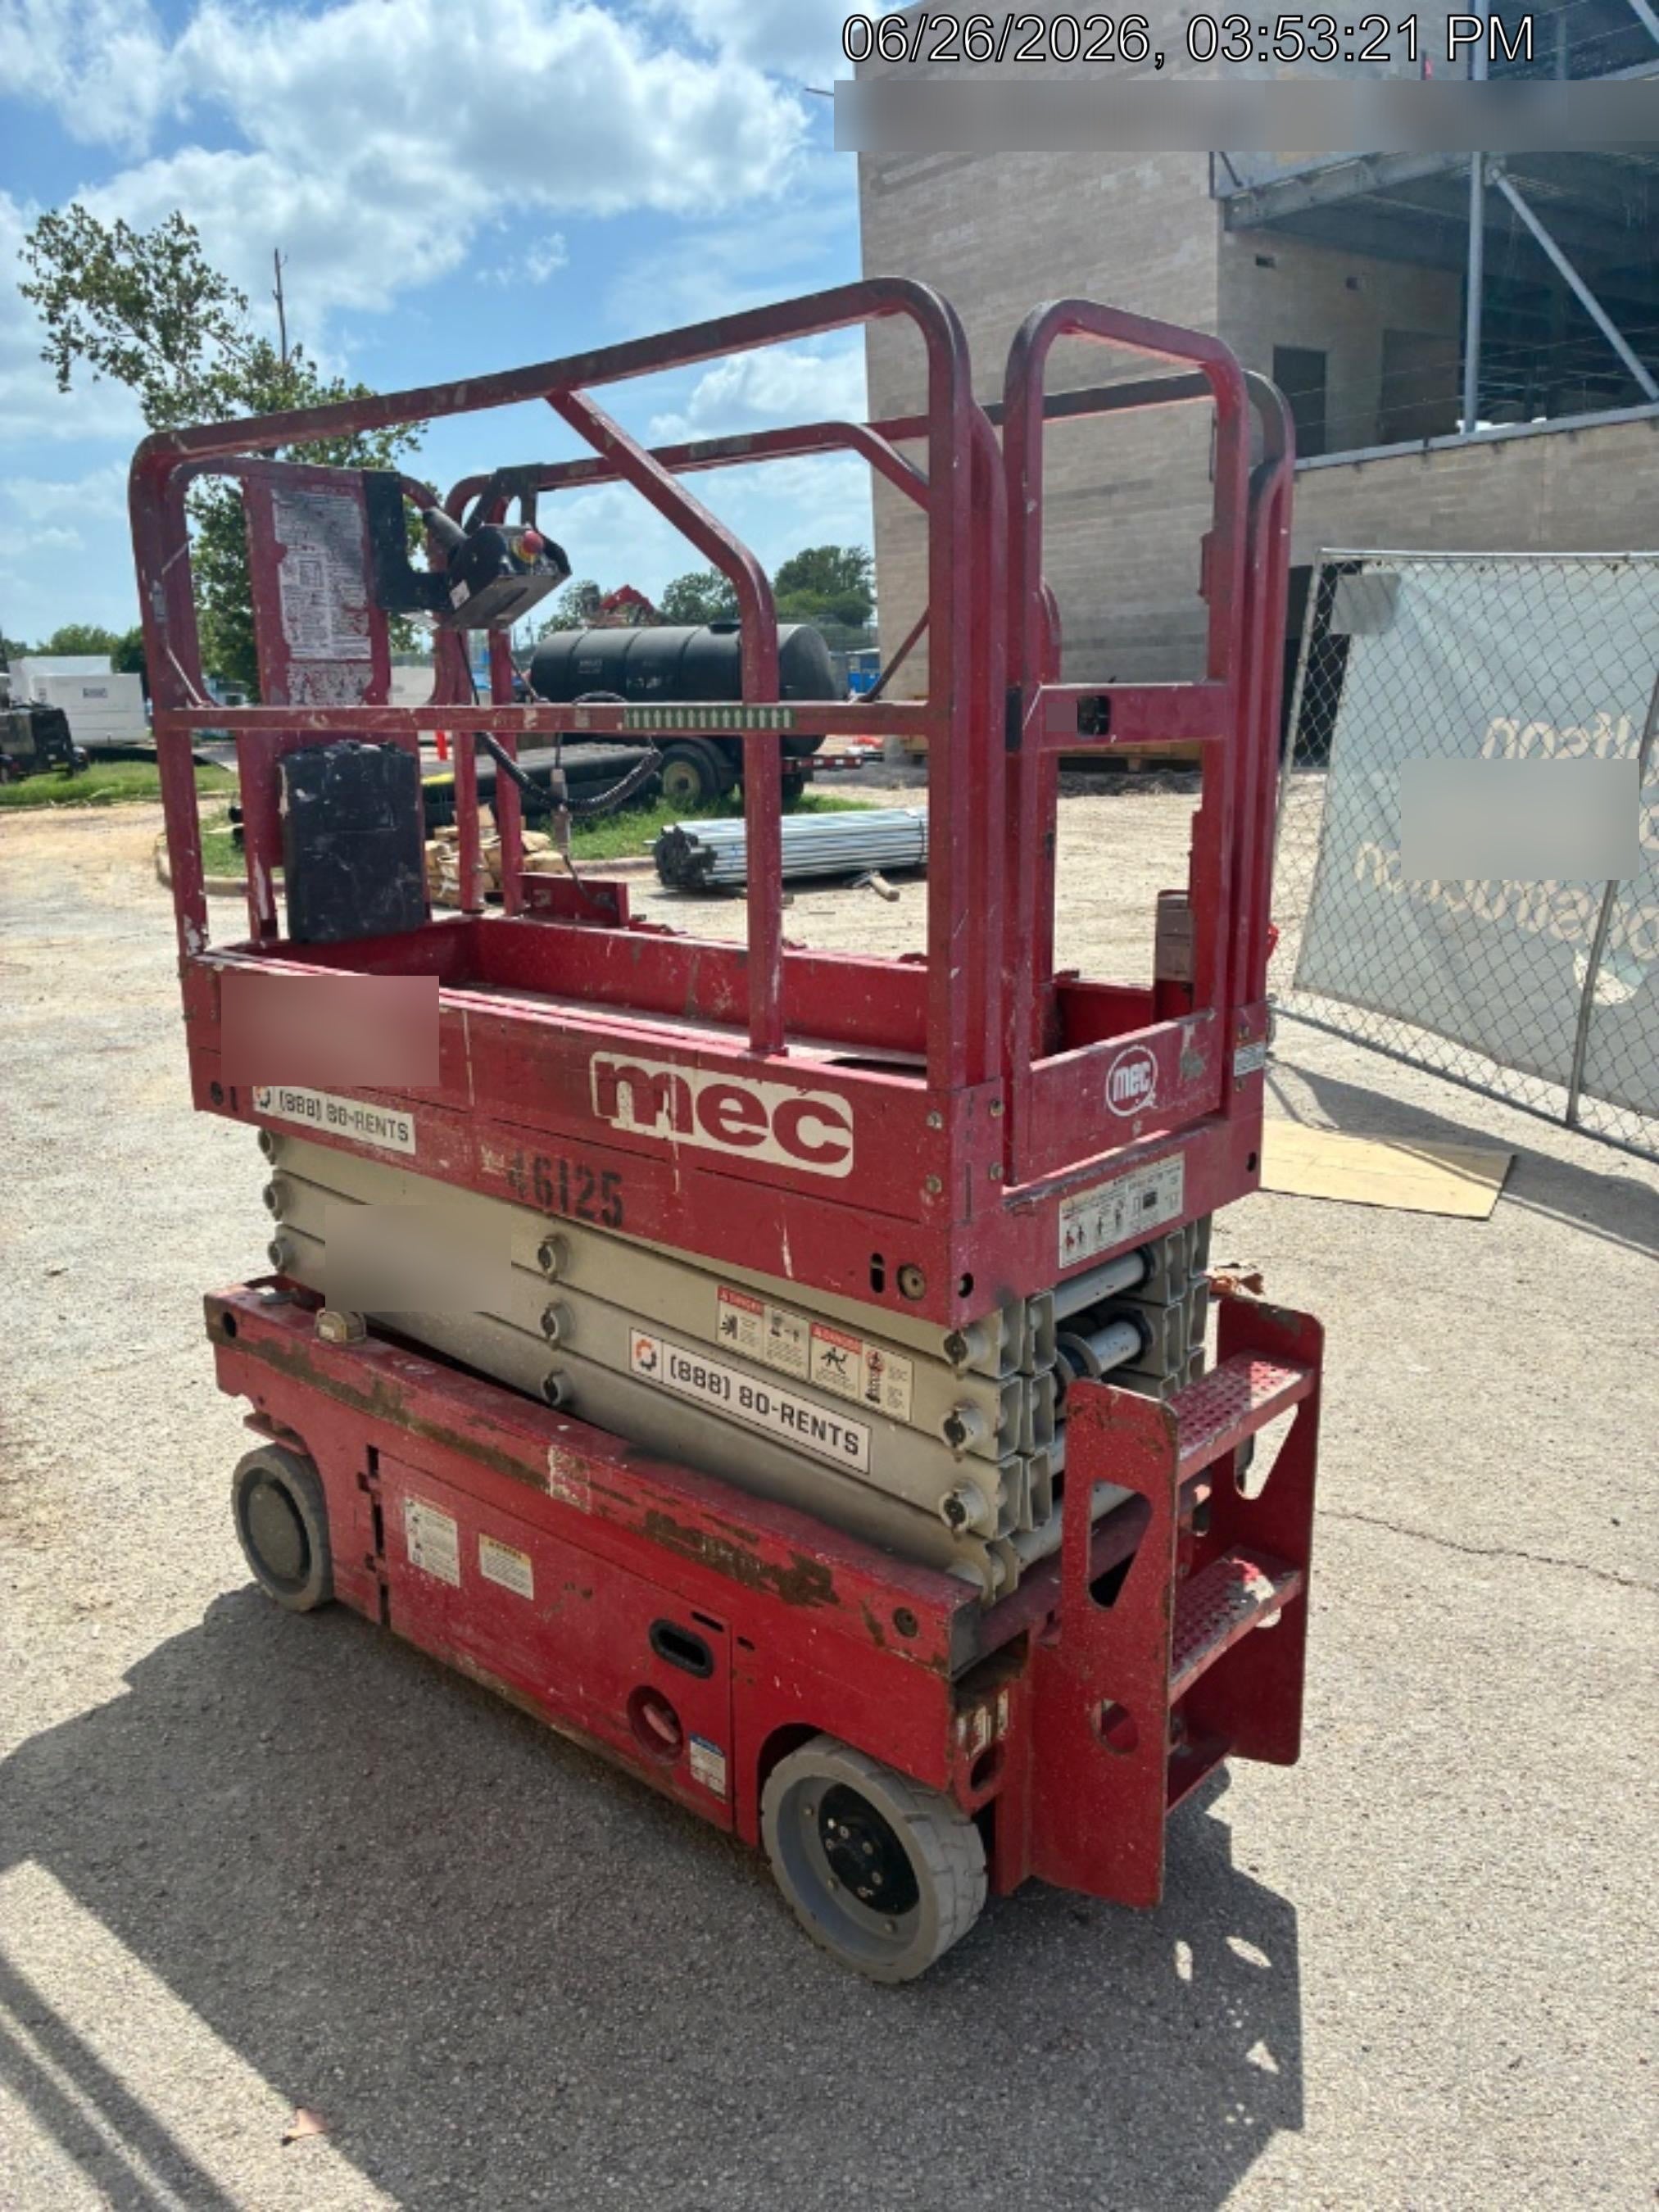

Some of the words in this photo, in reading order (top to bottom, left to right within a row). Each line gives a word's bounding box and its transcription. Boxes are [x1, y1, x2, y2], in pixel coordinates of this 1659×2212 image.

[279, 1090, 321, 1121] (888)
[326, 1103, 409, 1142] 80-RENTS
[594, 1059, 853, 1165] mec
[670, 1354, 731, 1402] (888)
[739, 1385, 859, 1456] 80-RENTS
